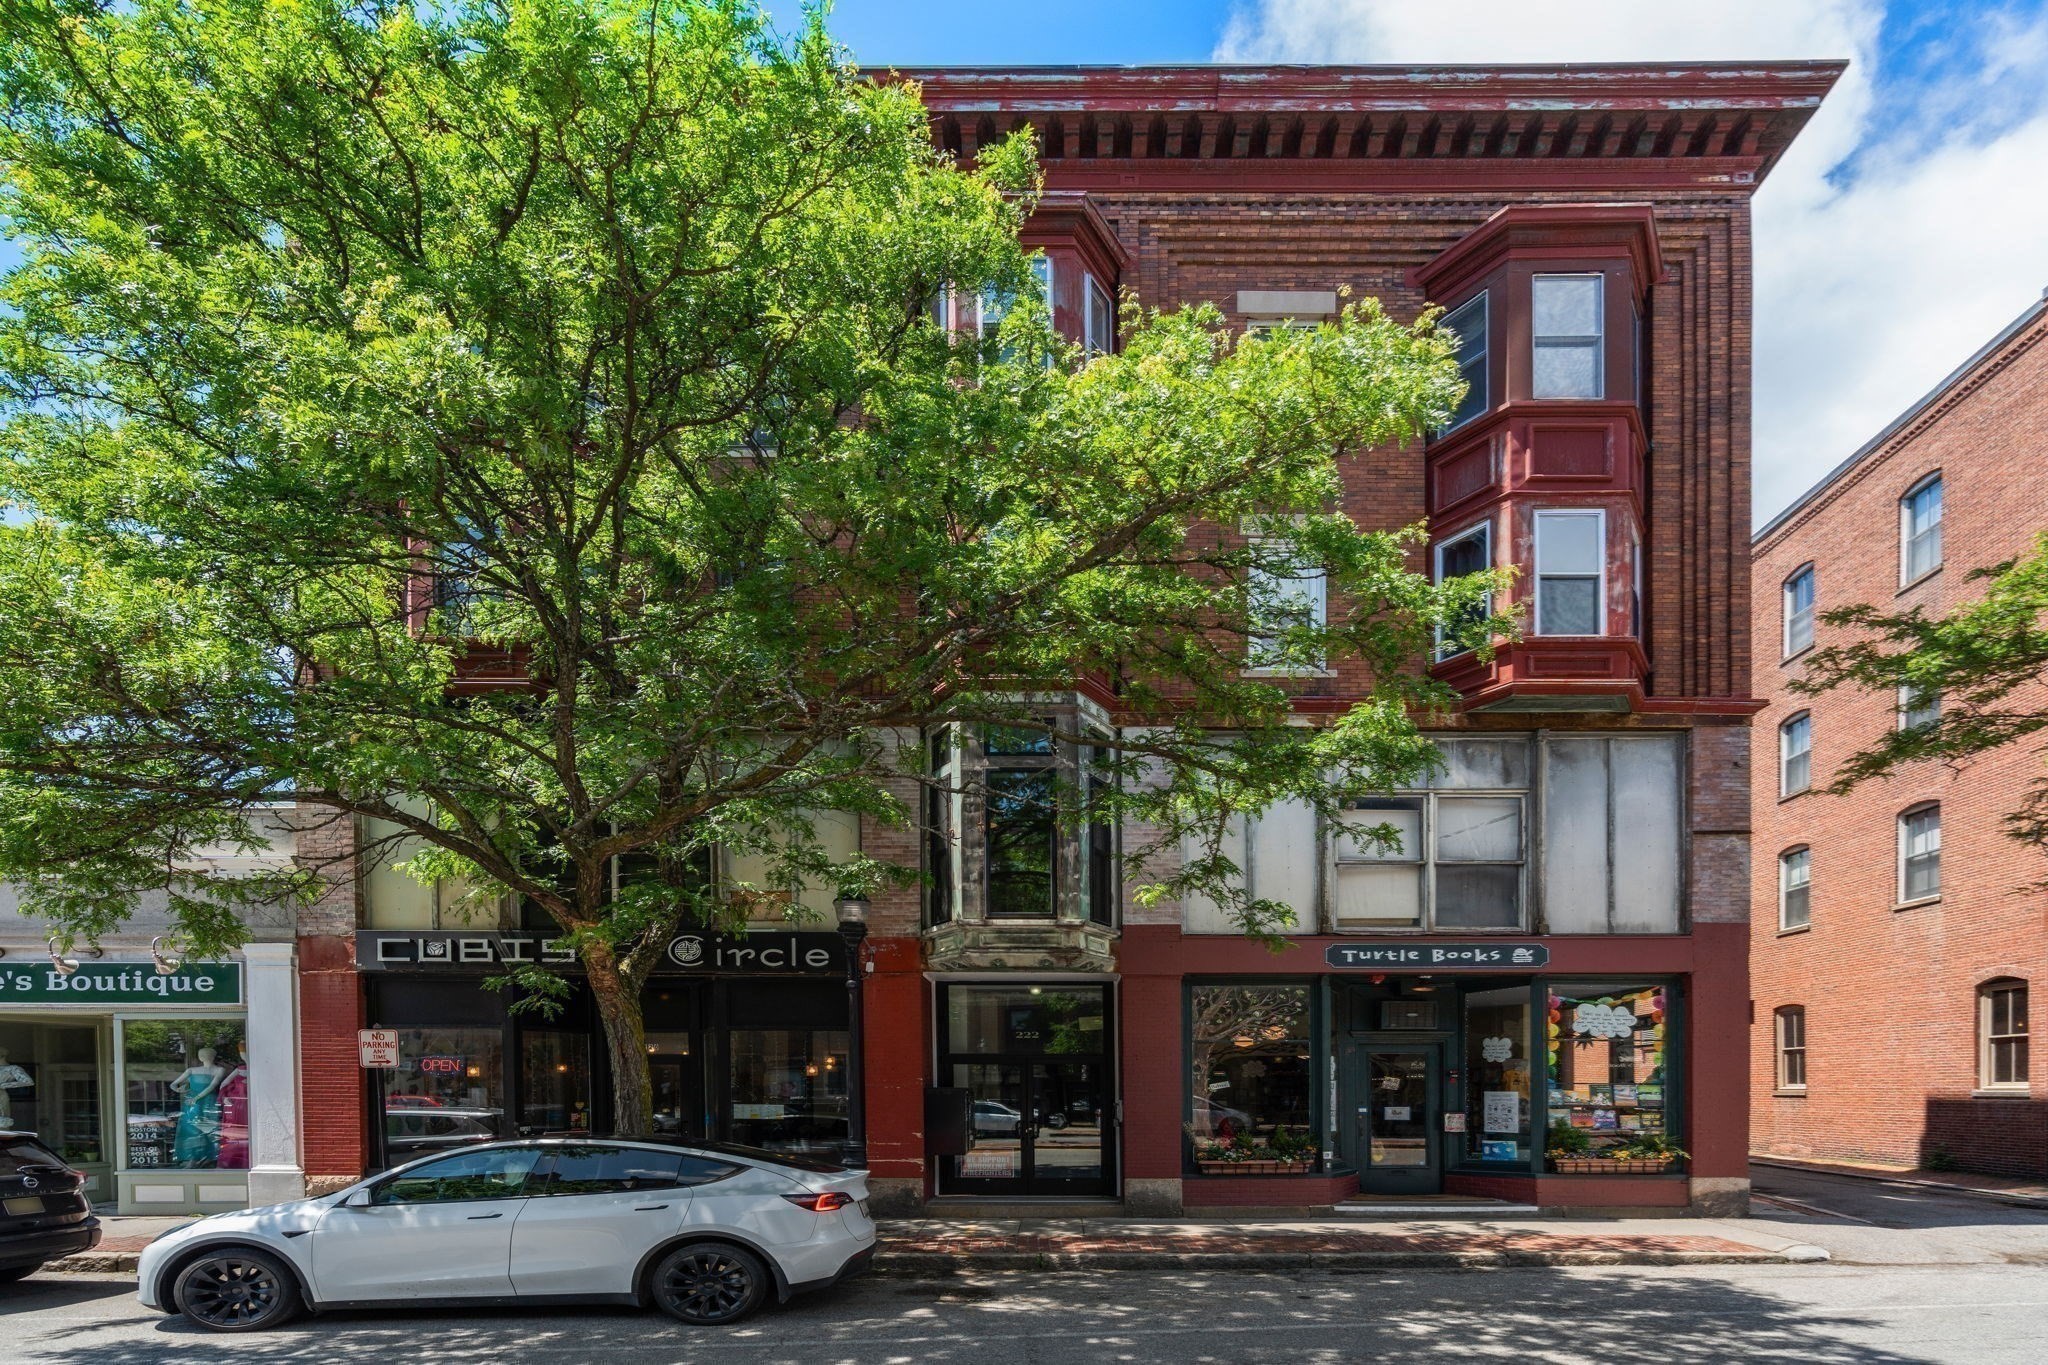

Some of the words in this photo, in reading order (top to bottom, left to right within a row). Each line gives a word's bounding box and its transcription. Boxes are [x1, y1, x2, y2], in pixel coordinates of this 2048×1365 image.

[377, 938, 576, 963] CUBIS
[668, 934, 830, 967] Circle
[1341, 949, 1420, 962] Turtle
[1431, 948, 1502, 963] Books
[0, 970, 33, 991] 's
[45, 970, 215, 996] Boutique
[1015, 1031, 1040, 1039] 222
[362, 1041, 396, 1049] PARKING
[422, 1059, 461, 1071] OPEN
[130, 1132, 157, 1140] 2014
[131, 1156, 159, 1164] 2015
